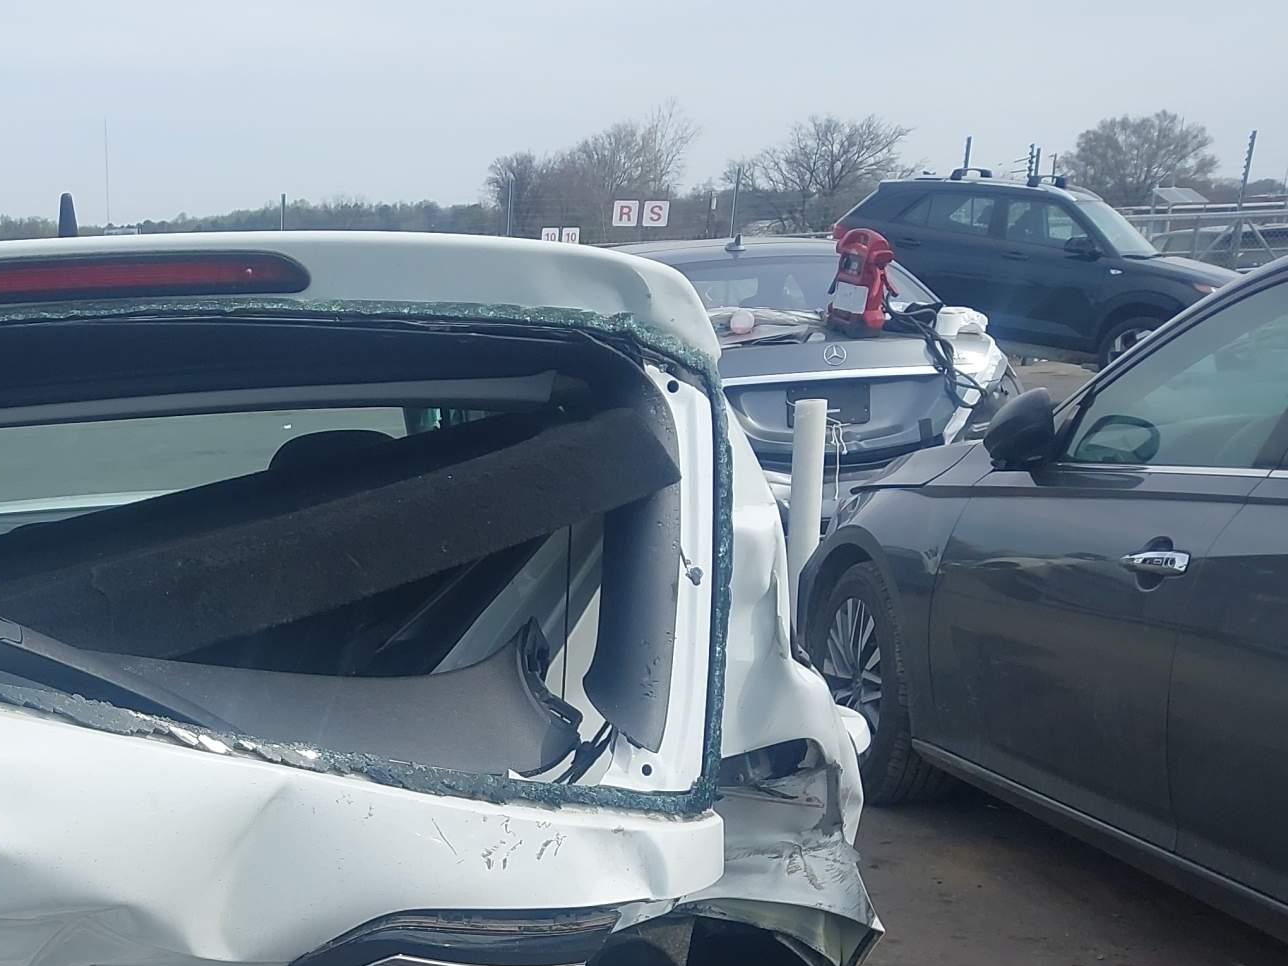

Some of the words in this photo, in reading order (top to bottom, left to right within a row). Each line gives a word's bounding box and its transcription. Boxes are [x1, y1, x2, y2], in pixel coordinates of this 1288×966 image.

[618, 205, 633, 222] R
[649, 205, 664, 222] S
[565, 232, 577, 242] 10
